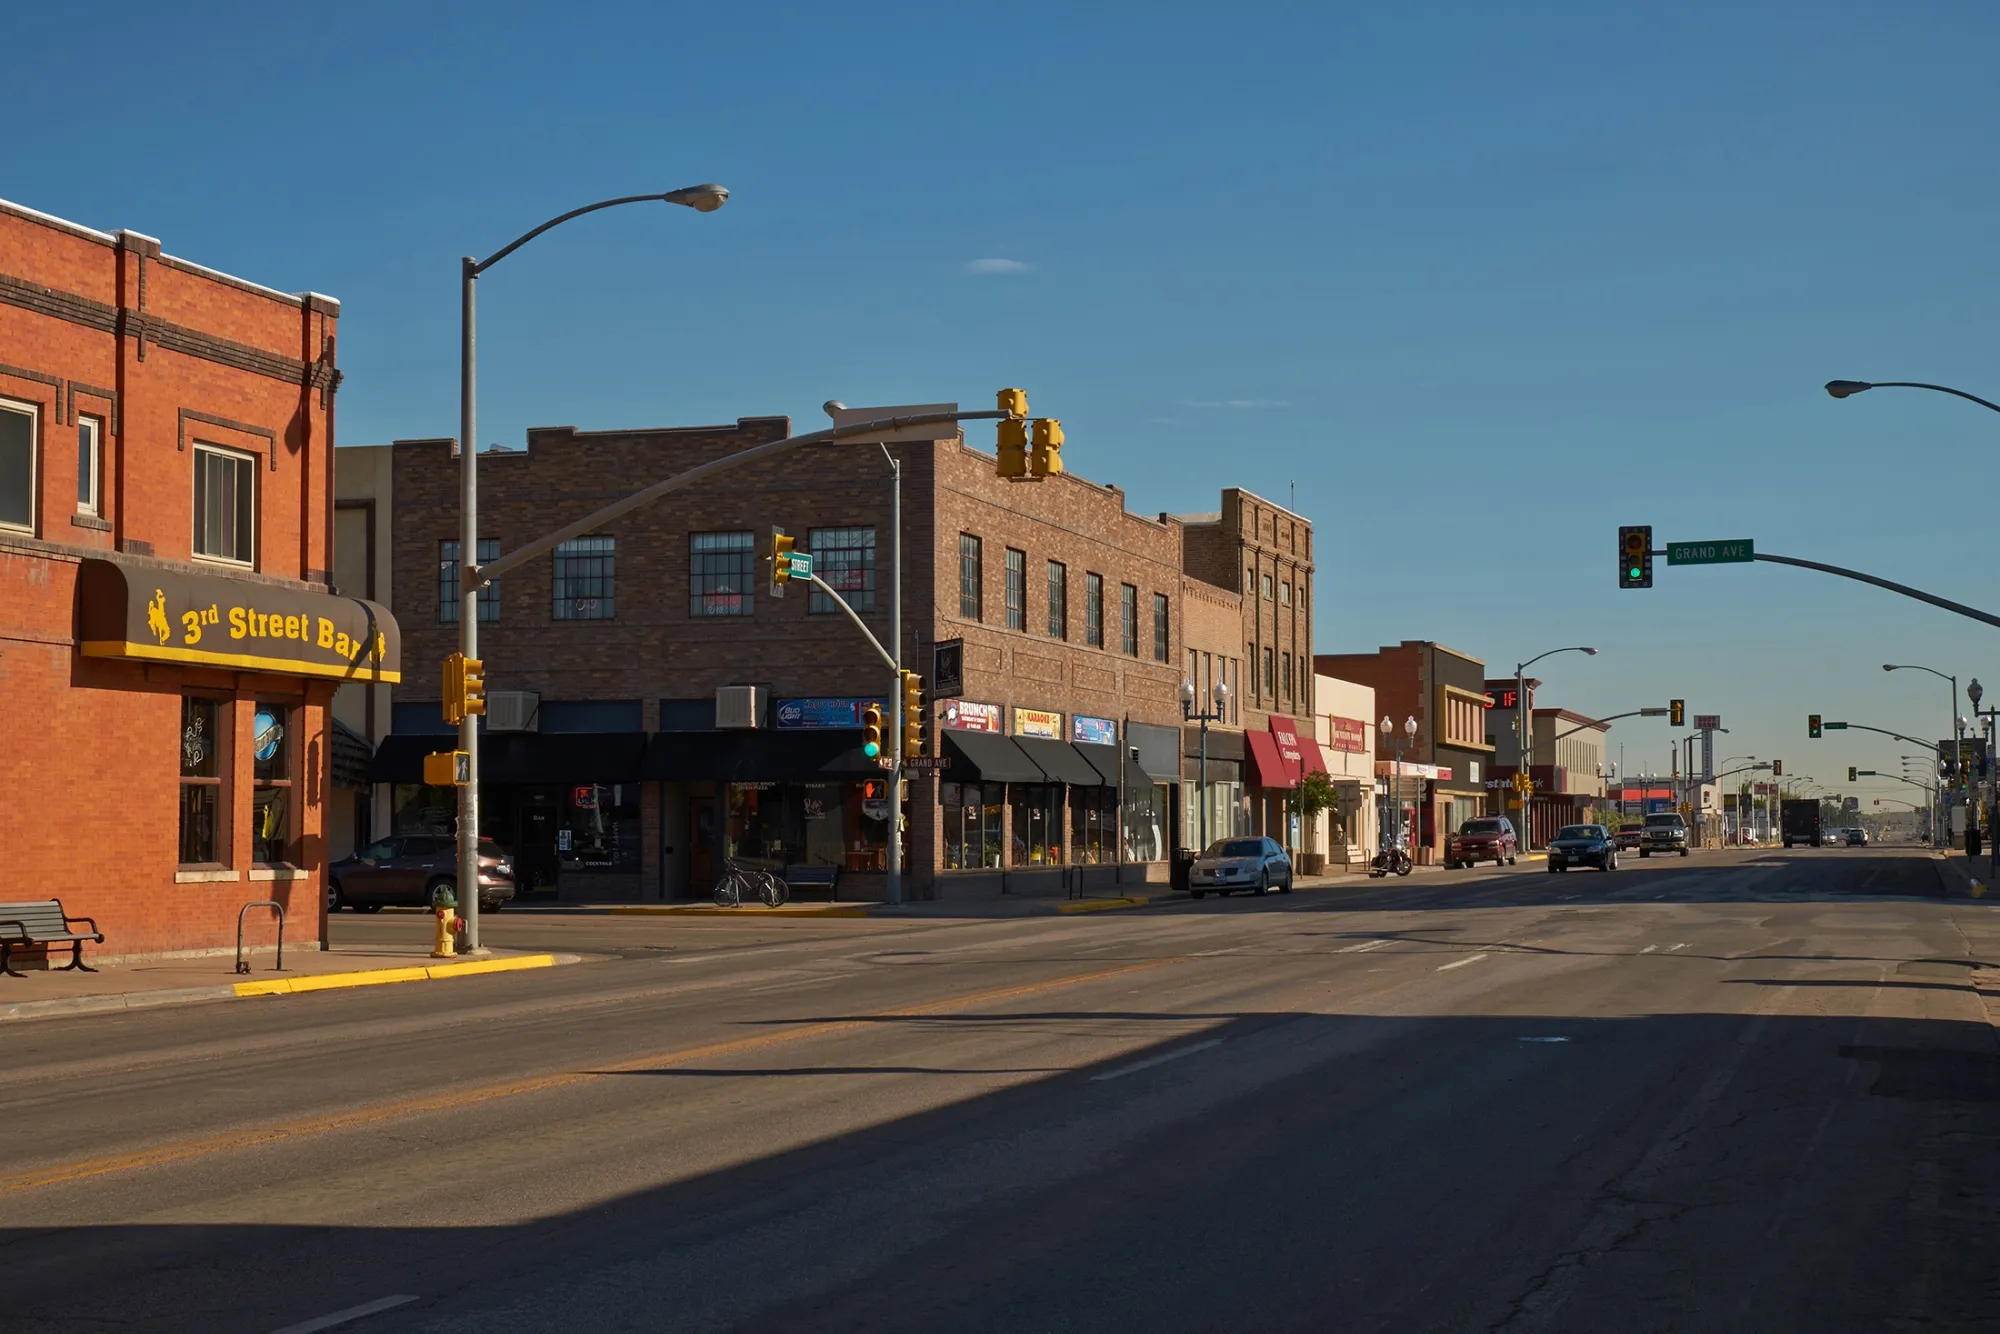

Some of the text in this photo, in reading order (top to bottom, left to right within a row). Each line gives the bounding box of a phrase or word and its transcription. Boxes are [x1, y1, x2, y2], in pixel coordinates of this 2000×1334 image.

[1675, 545, 1746, 561] GRAND AVE
[791, 558, 809, 573] STREET
[182, 604, 361, 662] 3rd Street Bar
[786, 713, 806, 721] LIGHT
[788, 706, 805, 715] BUD
[959, 702, 988, 717] BRUNCH
[1027, 712, 1050, 724] KARAOKE
[1277, 731, 1297, 746] FALCON
[910, 758, 947, 768] GRAND AVE
